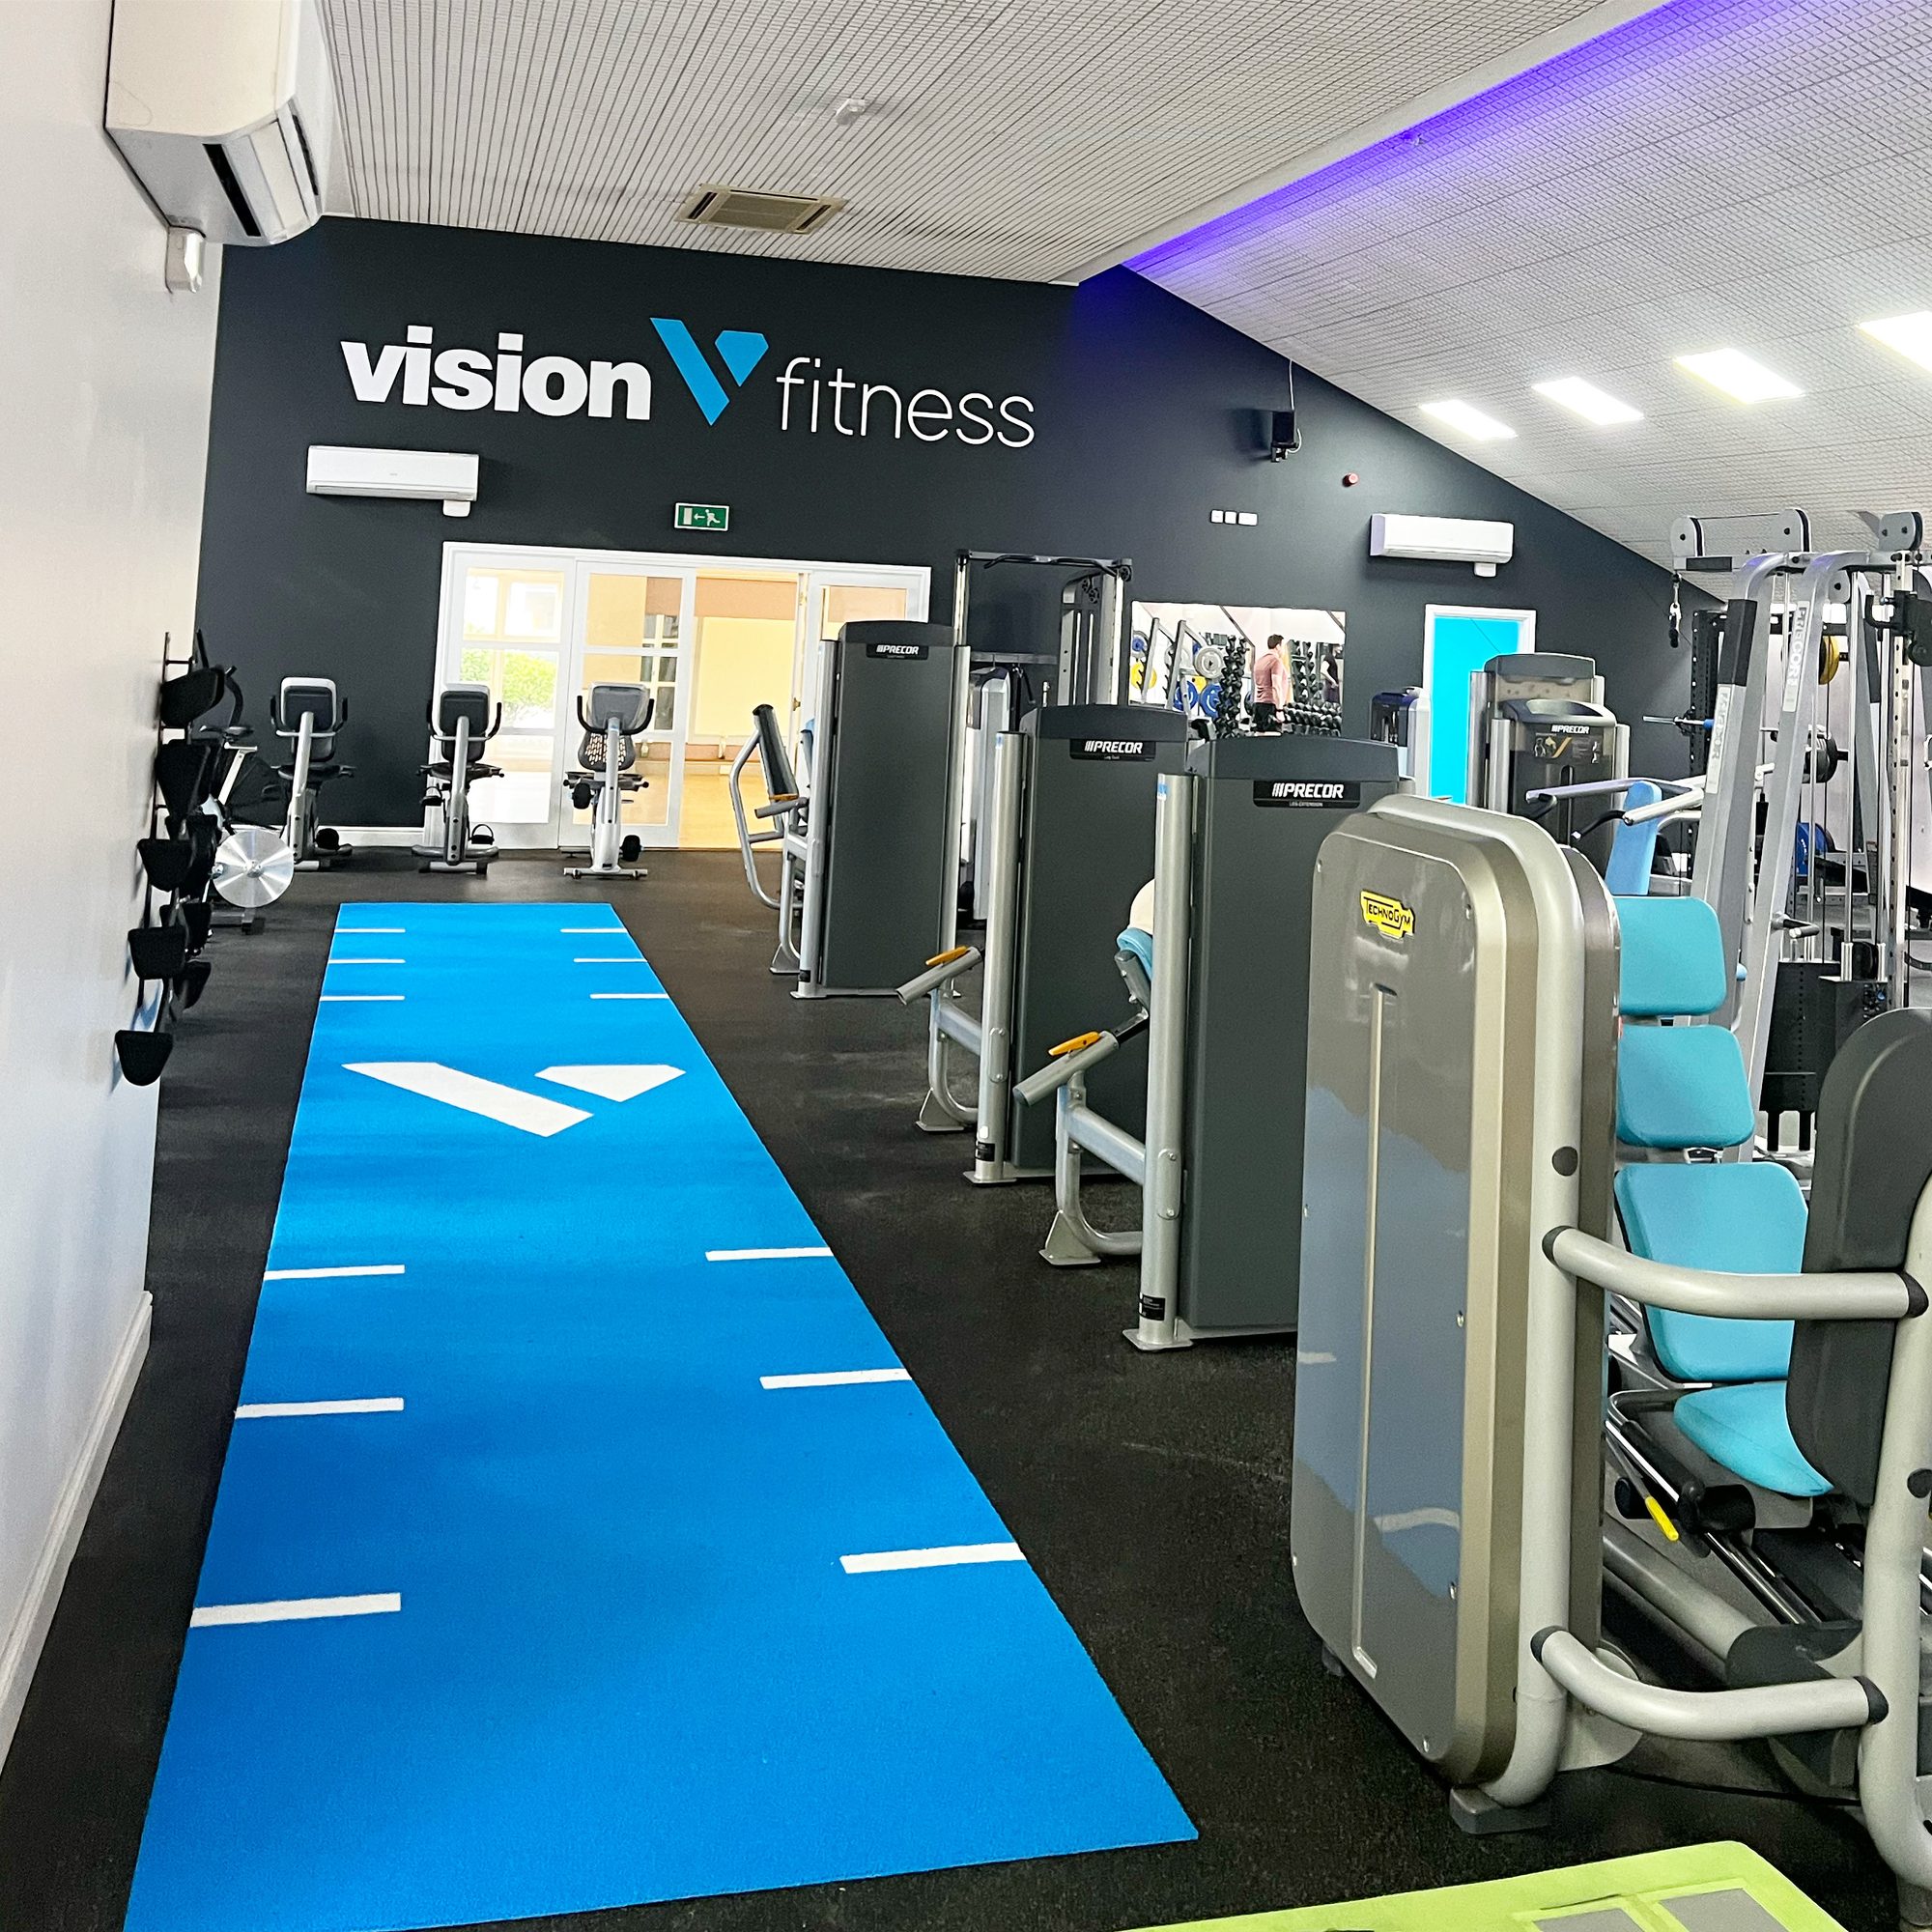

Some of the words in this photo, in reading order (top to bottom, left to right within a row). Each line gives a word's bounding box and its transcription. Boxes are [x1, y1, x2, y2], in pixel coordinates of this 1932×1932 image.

[340, 325, 652, 420] vision
[776, 356, 1035, 447] fitness
[882, 644, 919, 655] PRECOR
[1557, 724, 1590, 734] PRECOR
[1094, 740, 1144, 753] PRECOR
[1283, 782, 1345, 799] PRECOR
[1363, 896, 1410, 930] TECHNOGYM
